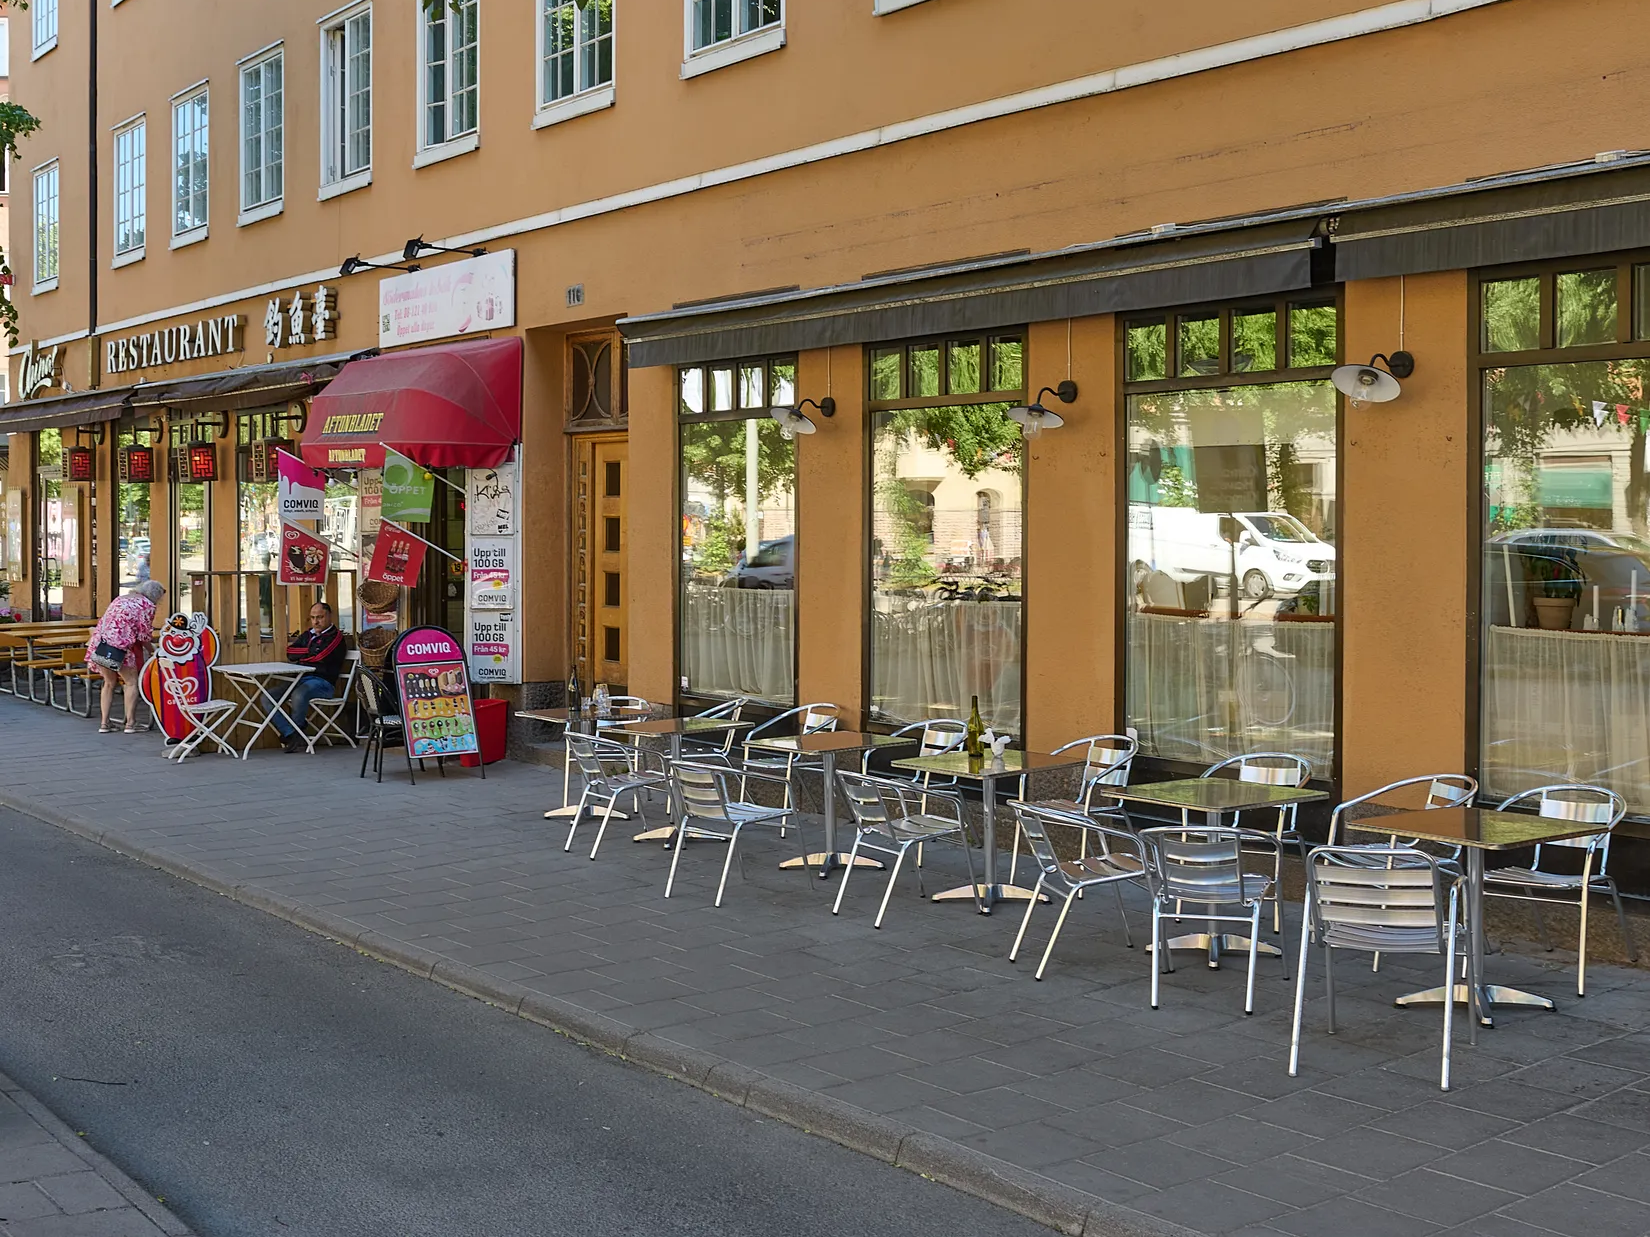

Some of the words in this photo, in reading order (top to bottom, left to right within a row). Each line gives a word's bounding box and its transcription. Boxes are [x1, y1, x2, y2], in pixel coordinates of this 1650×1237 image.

[106, 314, 238, 374] RESTAURANT
[322, 412, 384, 434] AFTONBLADET
[328, 448, 366, 462] AFTONBLADET
[389, 482, 426, 495] ÖPPET
[283, 499, 319, 509] COMVIQ
[474, 548, 491, 559] Upp
[493, 548, 506, 557] till
[474, 558, 491, 568] 100
[492, 558, 505, 568] GB
[382, 572, 404, 582] öppet
[478, 594, 507, 602] COMVIQ
[474, 622, 492, 632] Upp
[494, 622, 507, 632] till
[474, 633, 491, 642] 100
[493, 633, 505, 642] GB
[406, 642, 452, 655] COMVIQ
[474, 645, 489, 653] Från
[478, 668, 507, 676] COMVIQ
